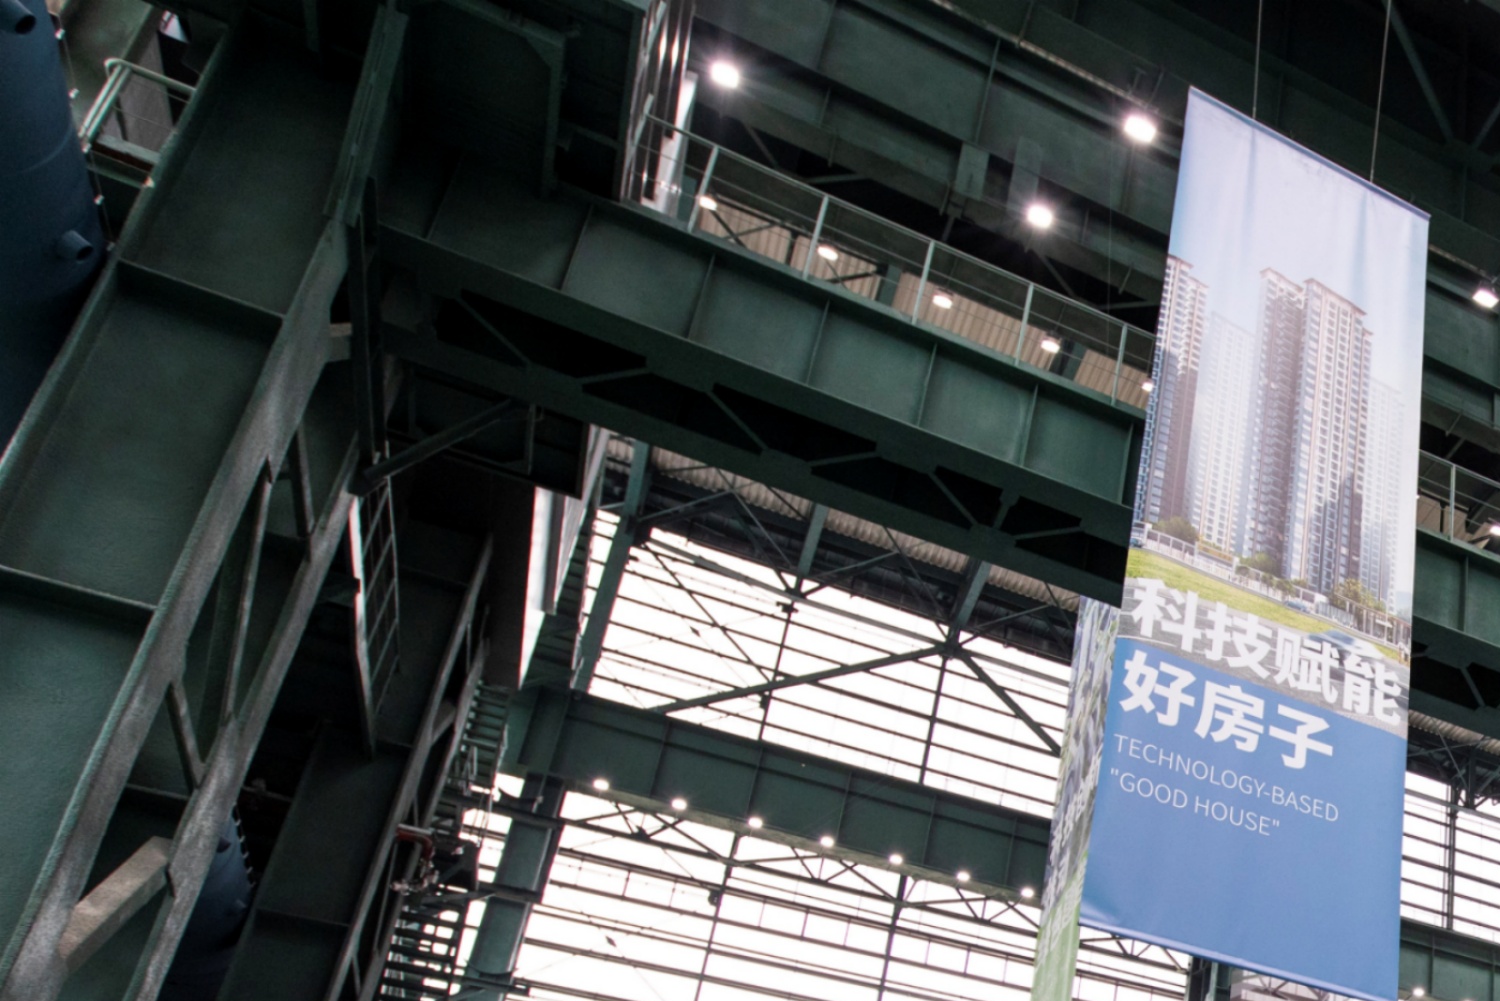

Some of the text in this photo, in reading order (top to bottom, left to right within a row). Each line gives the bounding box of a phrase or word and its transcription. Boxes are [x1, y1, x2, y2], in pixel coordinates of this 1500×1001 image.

[1130, 578, 1402, 726] 科技赋能
[1119, 651, 1333, 769] 好房子
[1111, 770, 1280, 836] "GOOD HOUSE"
[1114, 734, 1338, 822] TECHNOLOGY-BASED
